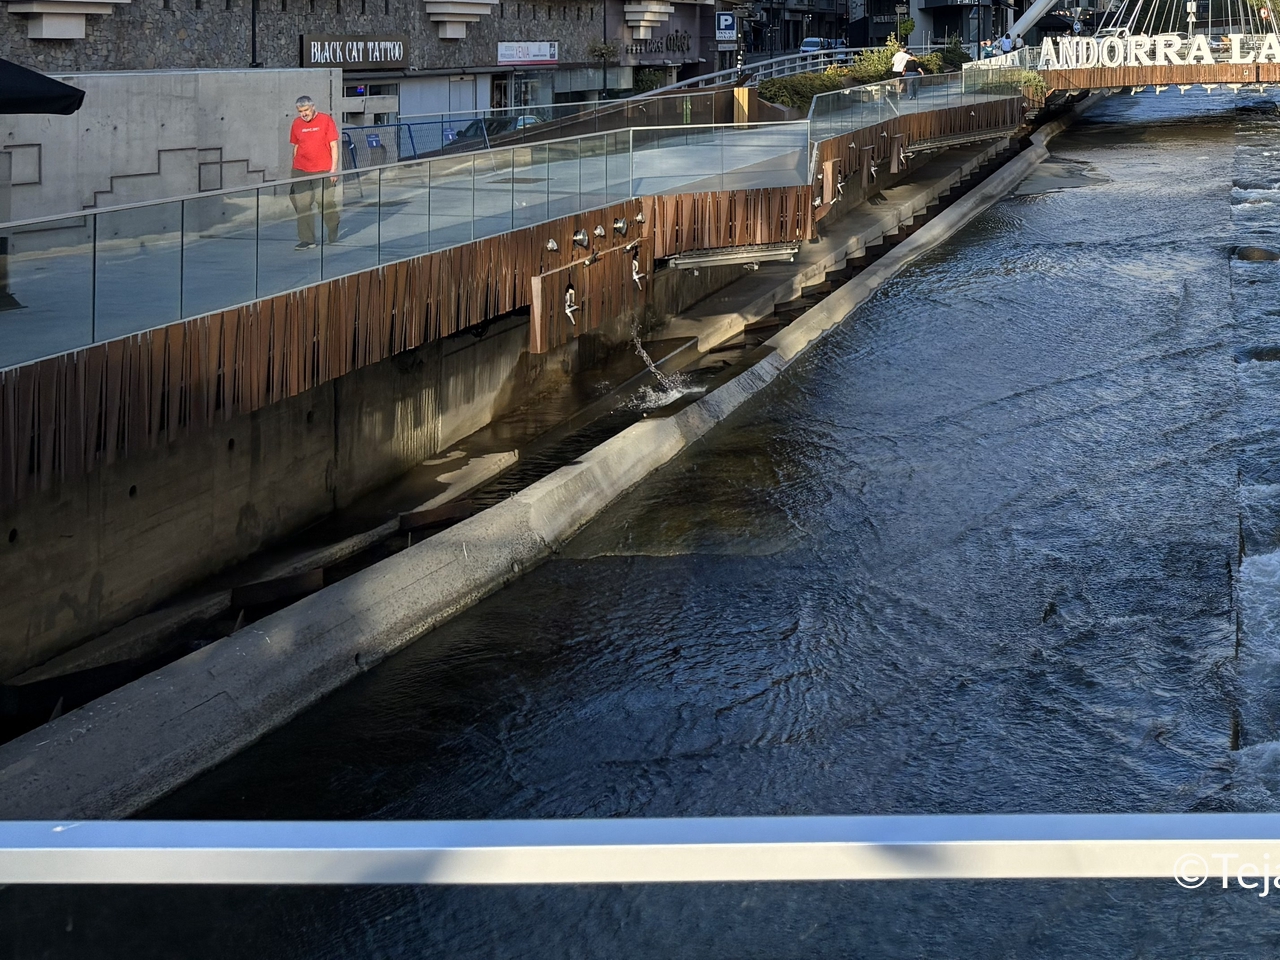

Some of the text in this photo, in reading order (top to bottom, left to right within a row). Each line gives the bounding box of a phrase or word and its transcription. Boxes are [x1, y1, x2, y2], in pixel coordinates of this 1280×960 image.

[720, 15, 733, 29] P
[311, 42, 404, 64] BLACK CAT TATTOO
[1038, 34, 1215, 70] ANDORRA
